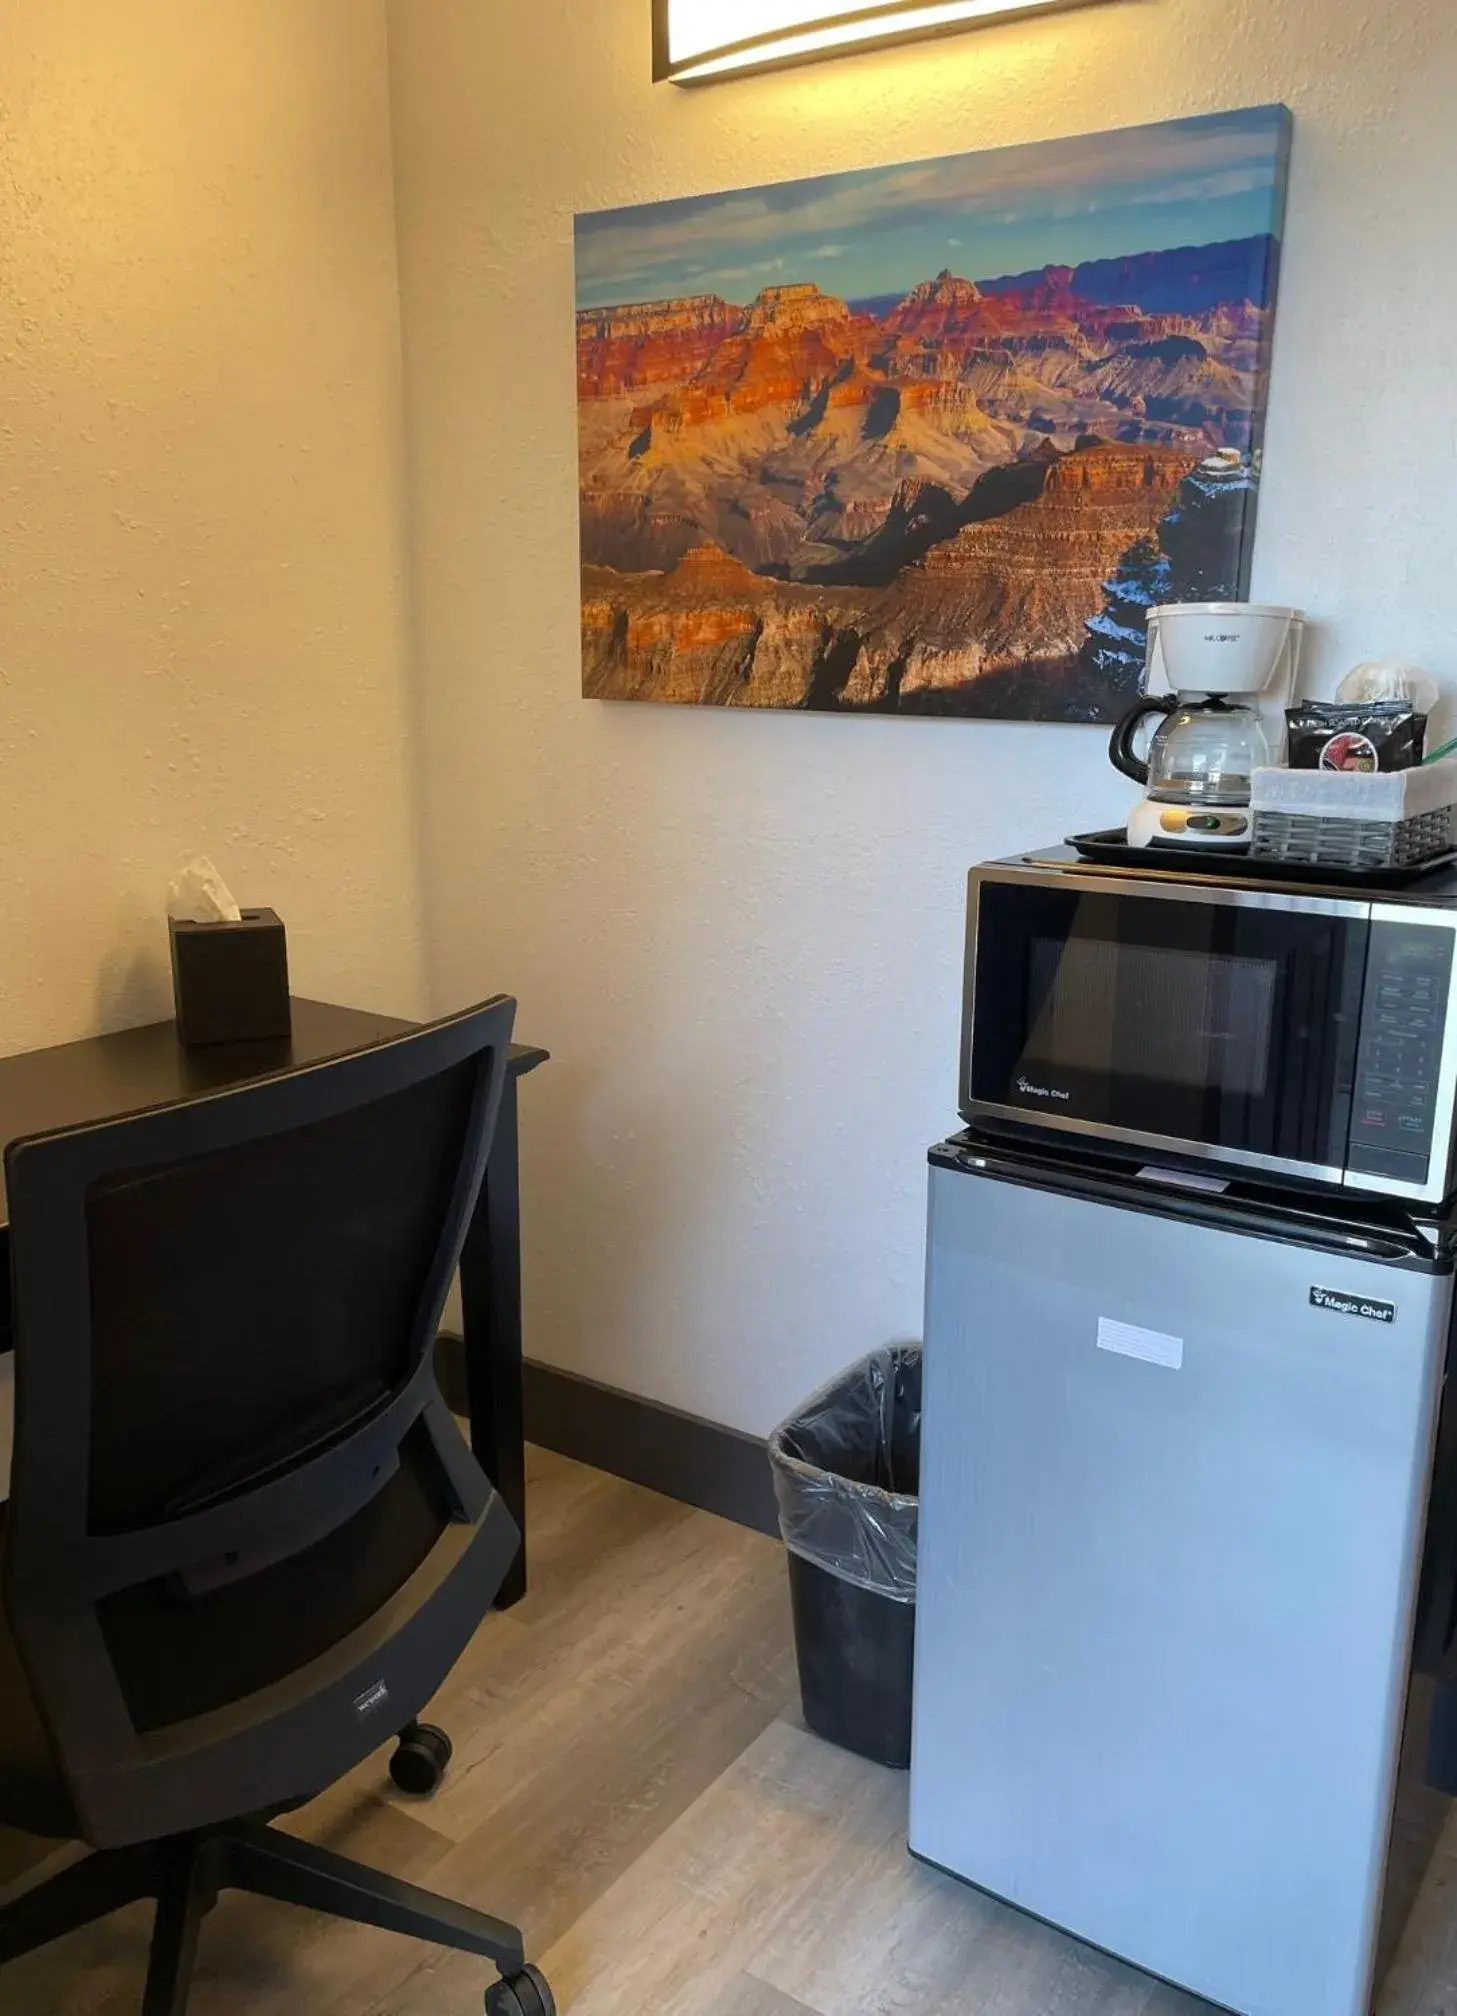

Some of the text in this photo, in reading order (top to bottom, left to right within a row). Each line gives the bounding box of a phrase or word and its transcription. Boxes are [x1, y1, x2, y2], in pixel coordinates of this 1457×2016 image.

[1026, 1084, 1070, 1099] Magic Chef
[1324, 1297, 1388, 1319] Magic Chef
